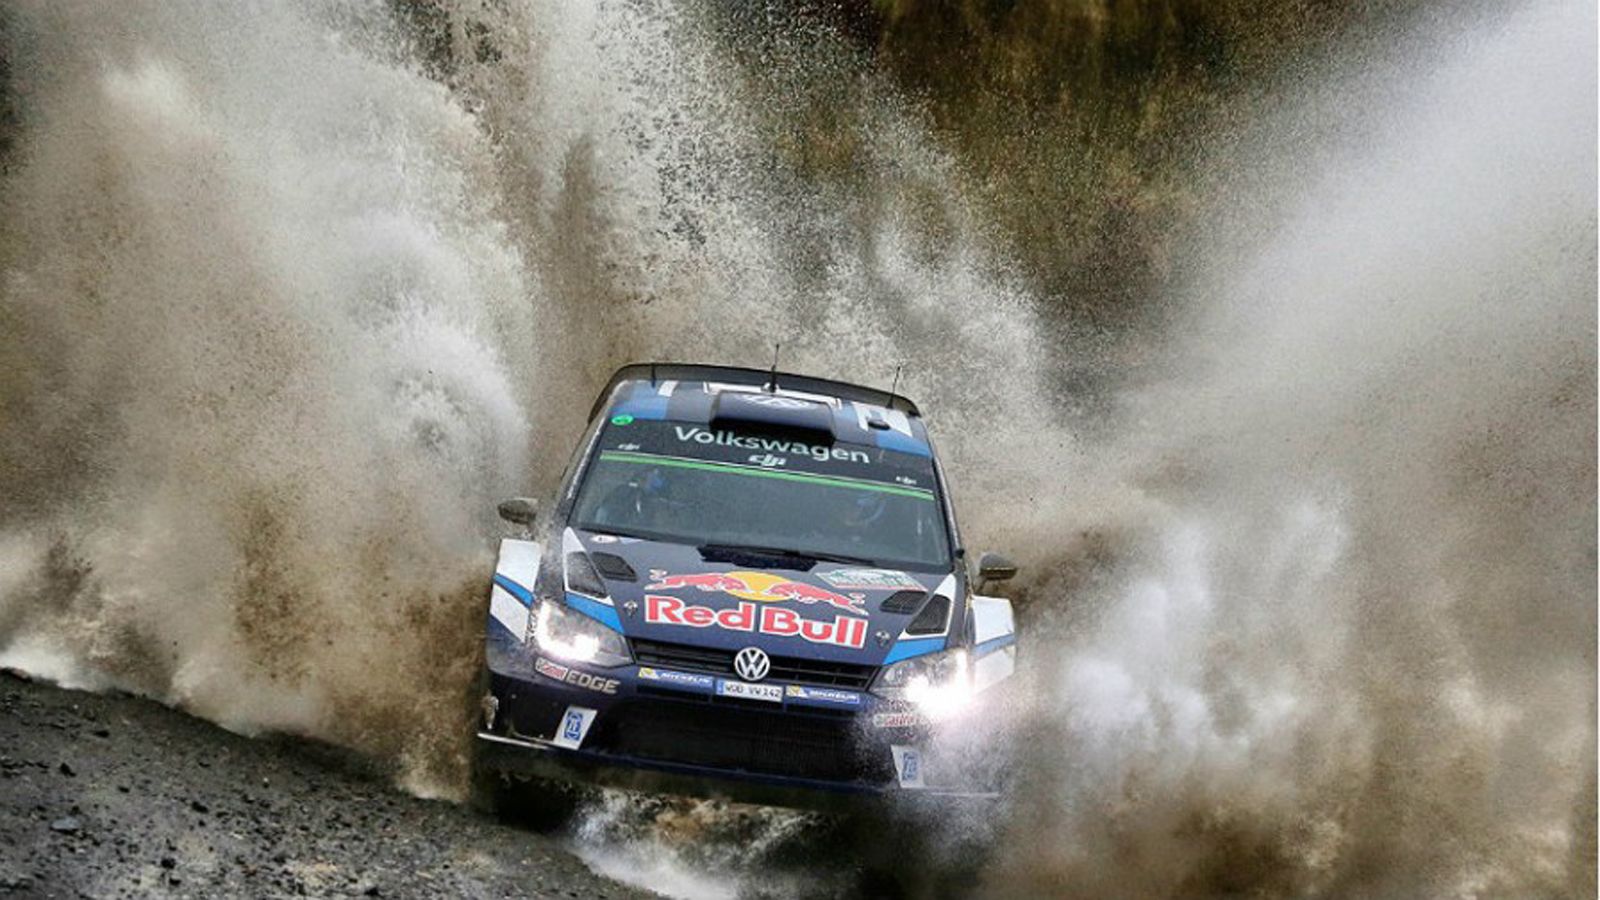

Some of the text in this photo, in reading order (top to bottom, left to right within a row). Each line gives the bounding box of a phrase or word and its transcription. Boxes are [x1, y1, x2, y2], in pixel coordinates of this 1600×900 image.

[675, 426, 870, 464] Volkswagen
[645, 595, 869, 649] Red Bull
[566, 670, 621, 694] EDGE
